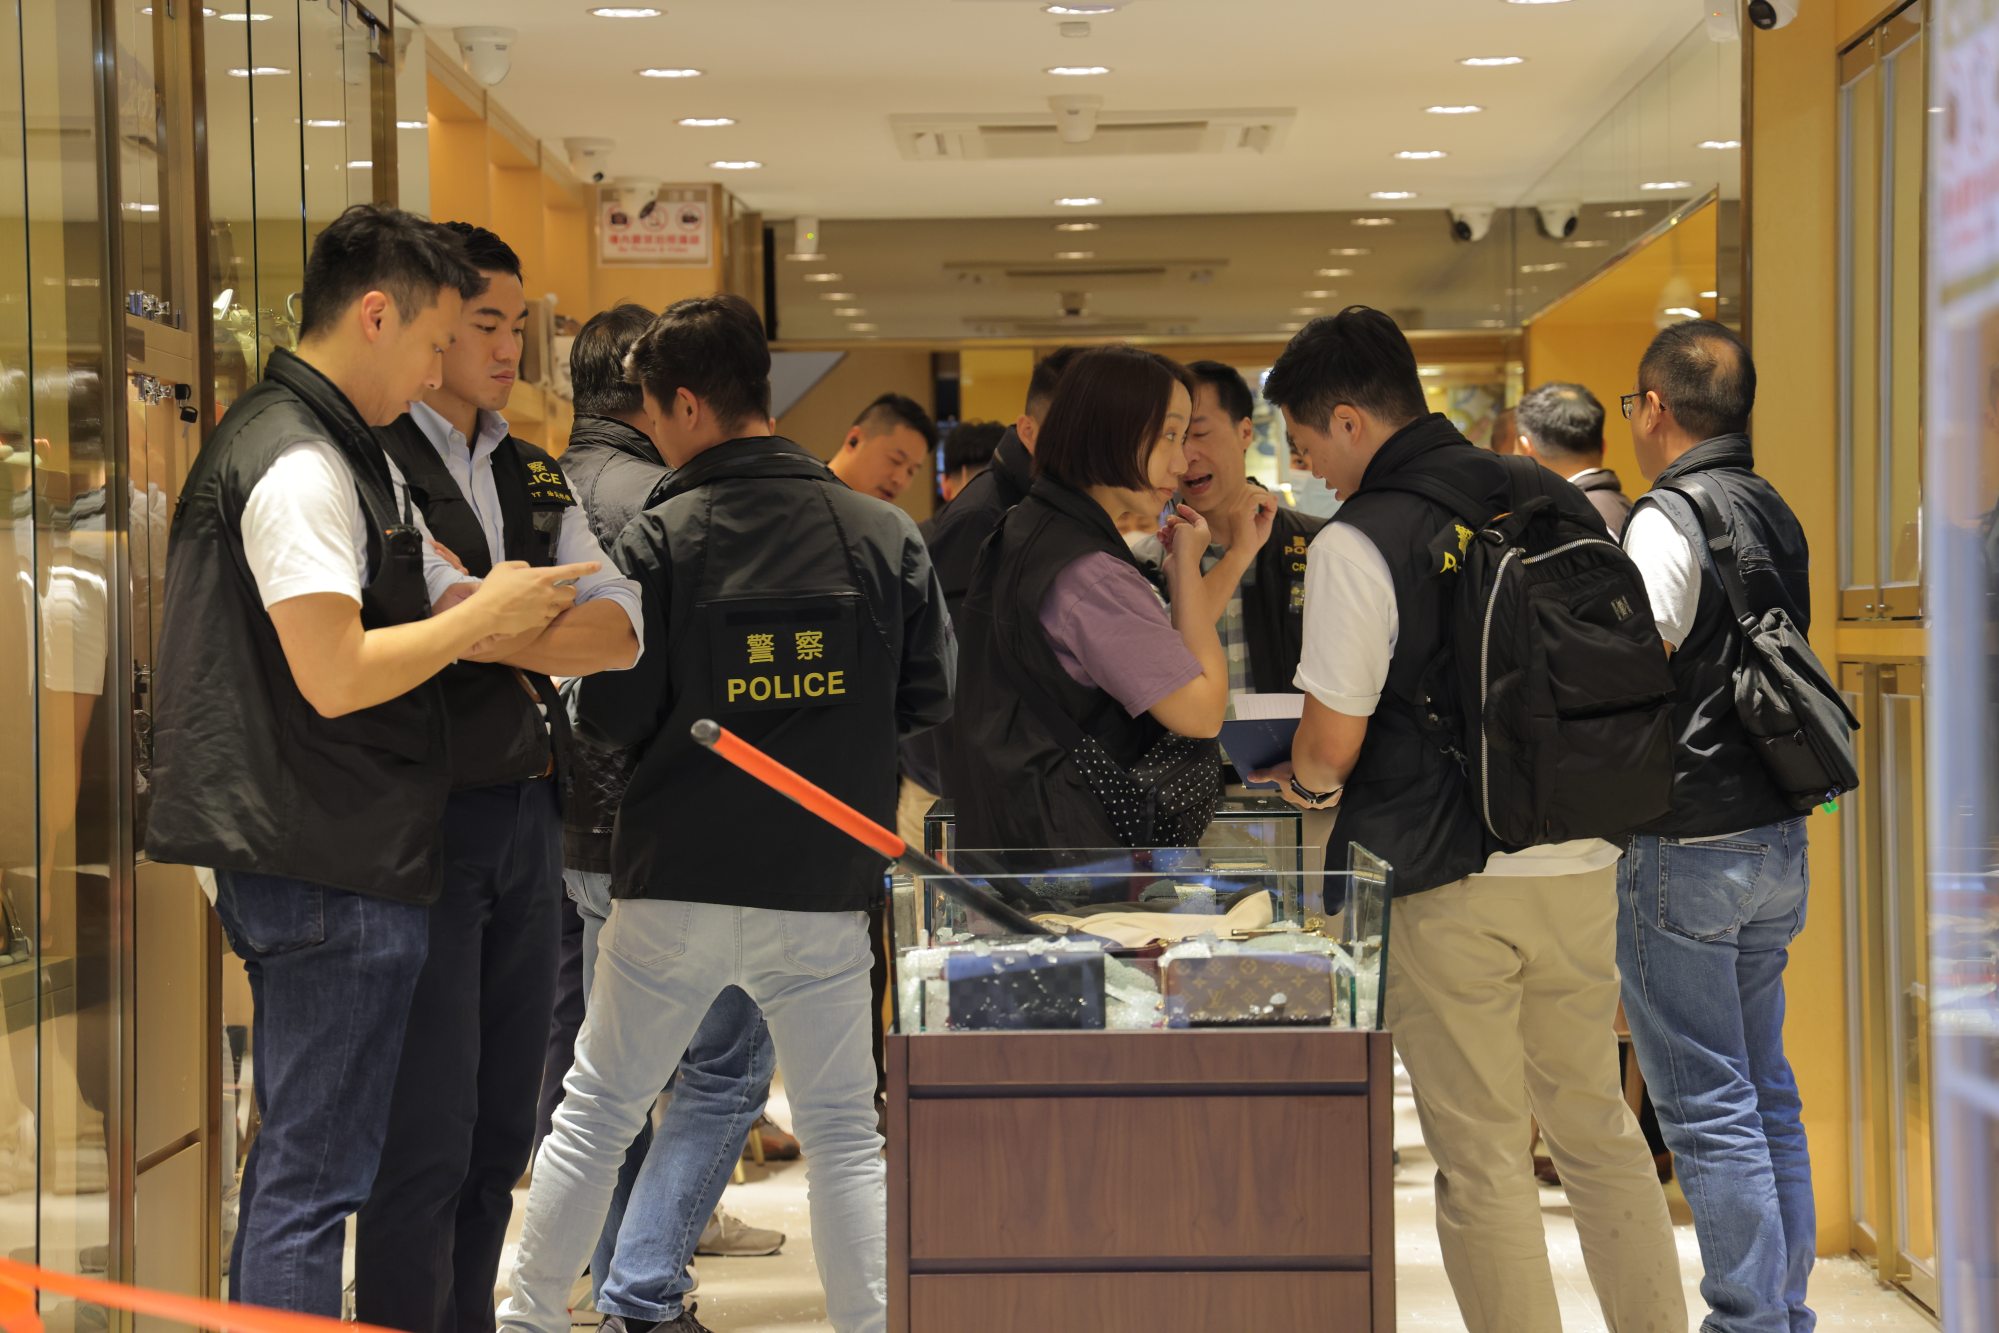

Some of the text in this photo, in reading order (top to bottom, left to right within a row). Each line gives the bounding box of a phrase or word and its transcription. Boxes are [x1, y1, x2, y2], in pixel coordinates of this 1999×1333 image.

[1284, 546, 1308, 555] PO
[747, 630, 824, 664] 警察
[727, 670, 847, 702] POLICE
